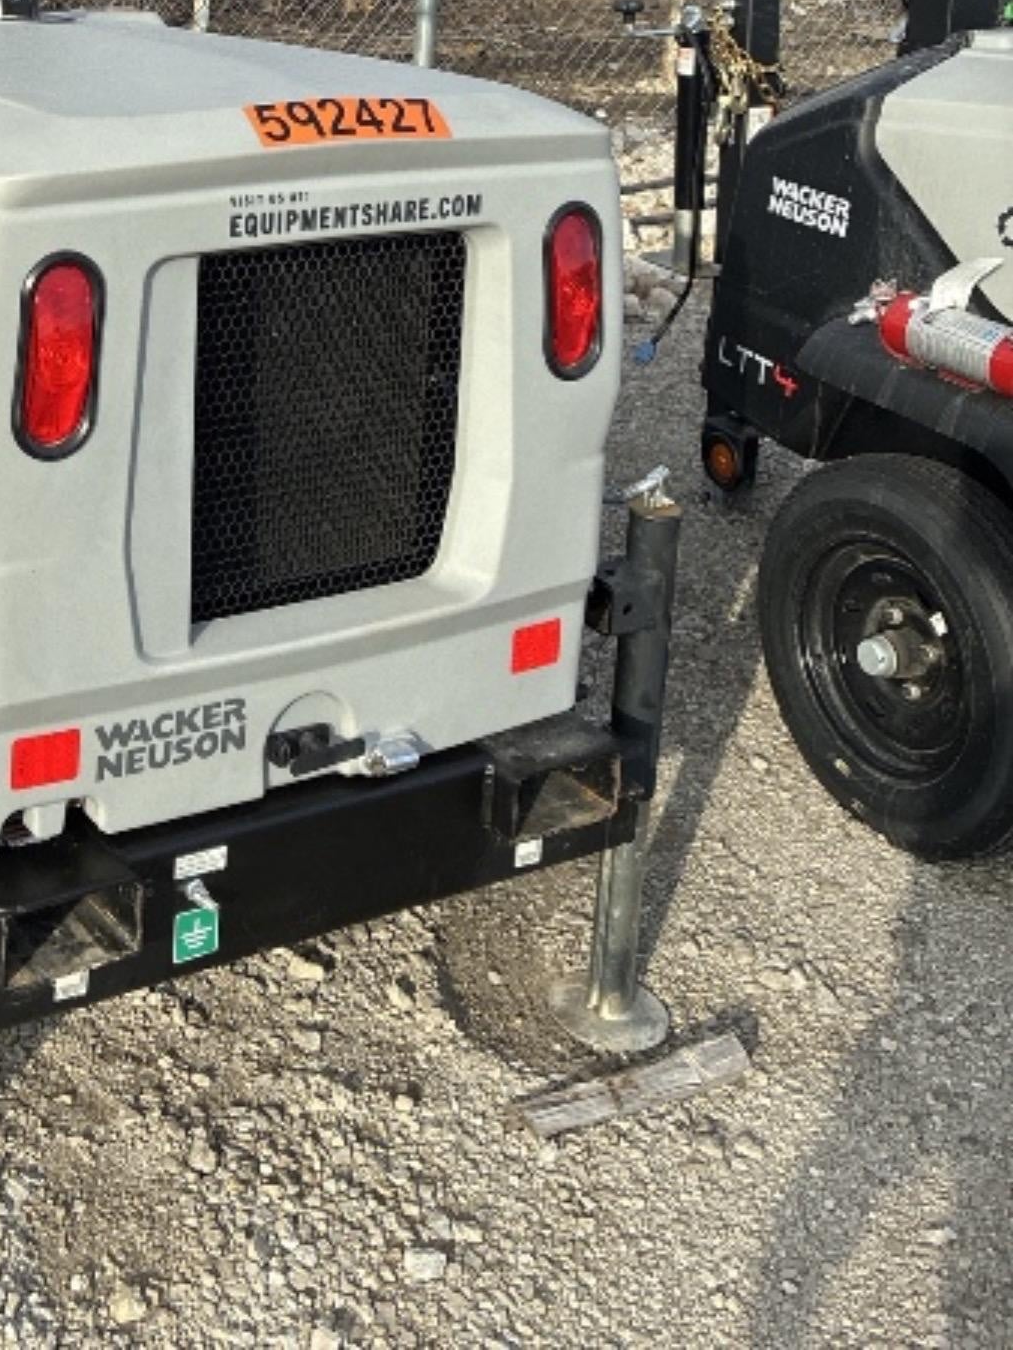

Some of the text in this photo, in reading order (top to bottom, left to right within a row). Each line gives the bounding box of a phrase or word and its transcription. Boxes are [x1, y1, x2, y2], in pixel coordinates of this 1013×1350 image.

[253, 98, 435, 141] 592427
[229, 193, 483, 238] EQUIPMENTSHARE.COM
[767, 194, 849, 238] NEUSON
[772, 176, 851, 220] WACKER
[718, 335, 797, 397] LTT4
[94, 698, 247, 751] WACKER
[95, 724, 246, 783] NEUSON
